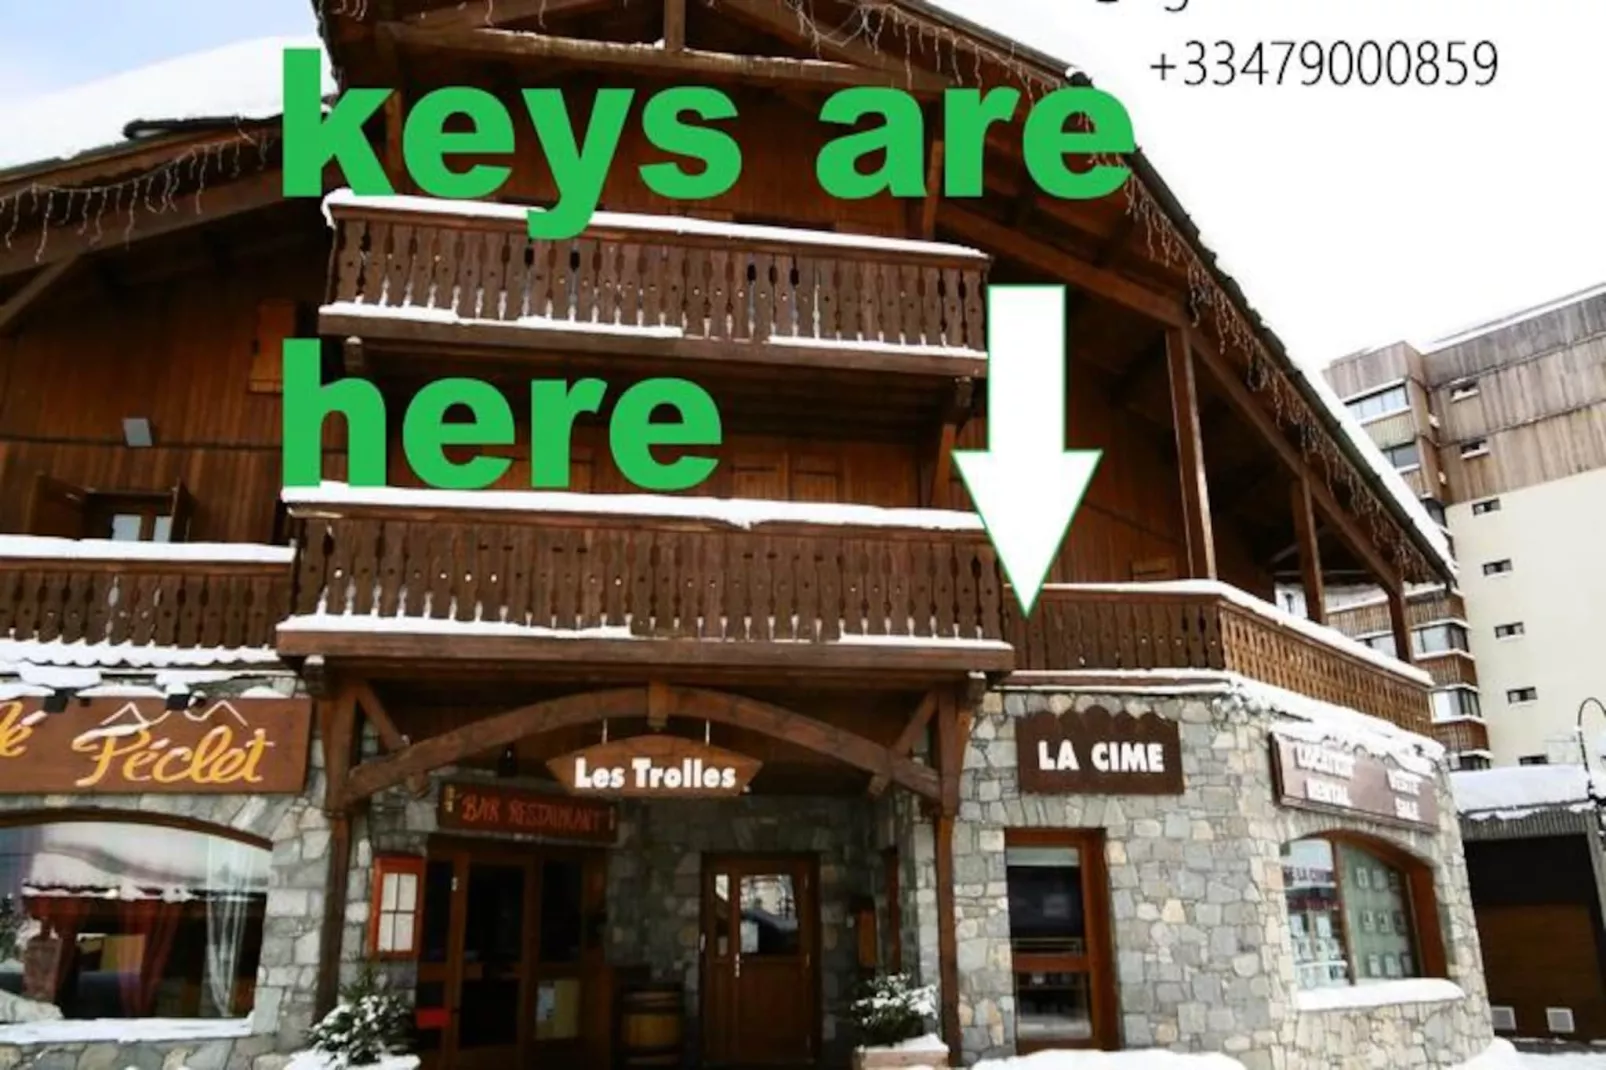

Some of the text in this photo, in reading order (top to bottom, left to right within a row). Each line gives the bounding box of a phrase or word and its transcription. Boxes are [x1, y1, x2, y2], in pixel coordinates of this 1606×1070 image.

[72, 724, 275, 787] Péclet
[1037, 740, 1165, 773] LA CIME
[574, 757, 737, 789] Les Trolles
